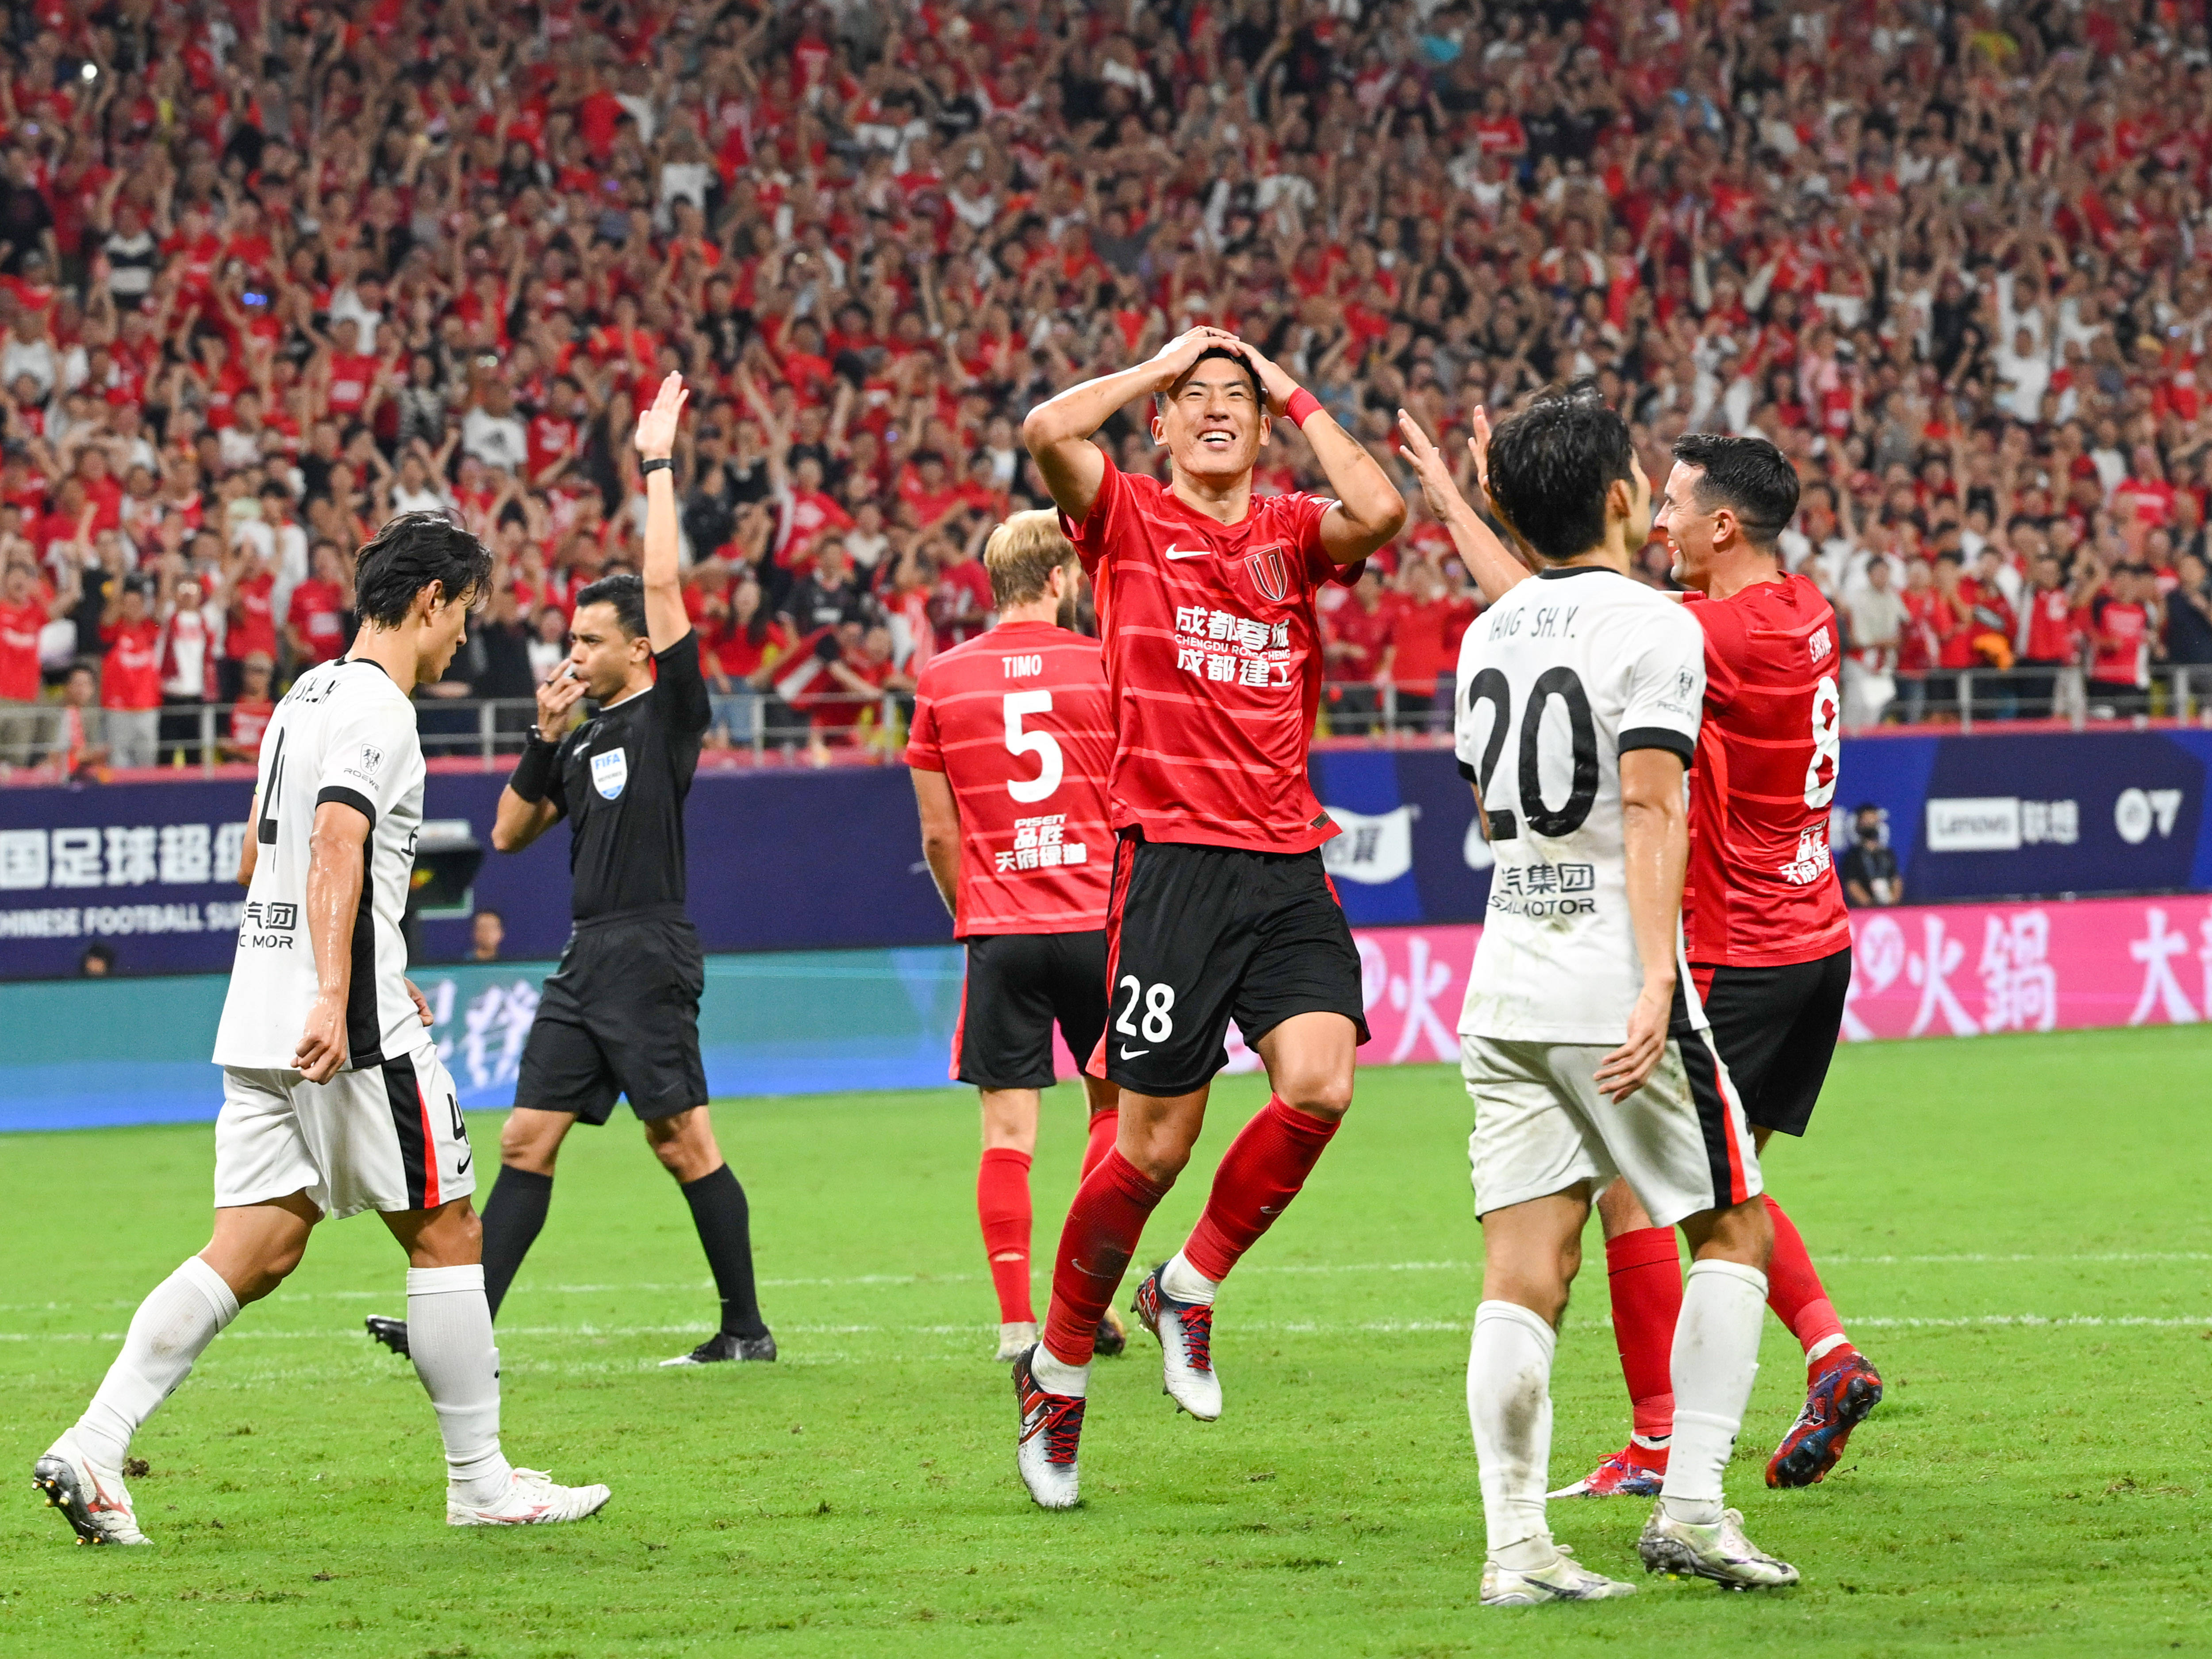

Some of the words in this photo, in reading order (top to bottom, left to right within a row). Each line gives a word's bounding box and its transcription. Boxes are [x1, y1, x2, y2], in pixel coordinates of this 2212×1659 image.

[1174, 634, 1229, 653] CHENGDU
[1232, 645, 1290, 661] ROCHENG
[1002, 655, 1042, 678] TIMO
[1177, 648, 1291, 687] 成都建工
[1003, 689, 1064, 803] 5
[1469, 666, 1599, 841] 20
[1804, 676, 1839, 810] 8
[344, 768, 380, 791] ROEWE
[595, 754, 620, 770] FIFA
[1014, 825, 1065, 850] 品胜
[995, 842, 1087, 872] 天府绿道
[84, 902, 202, 936] FOOTBALL
[2128, 906, 2212, 1025] 大
[1116, 975, 1175, 1043] 28
[447, 1093, 469, 1145] 4
